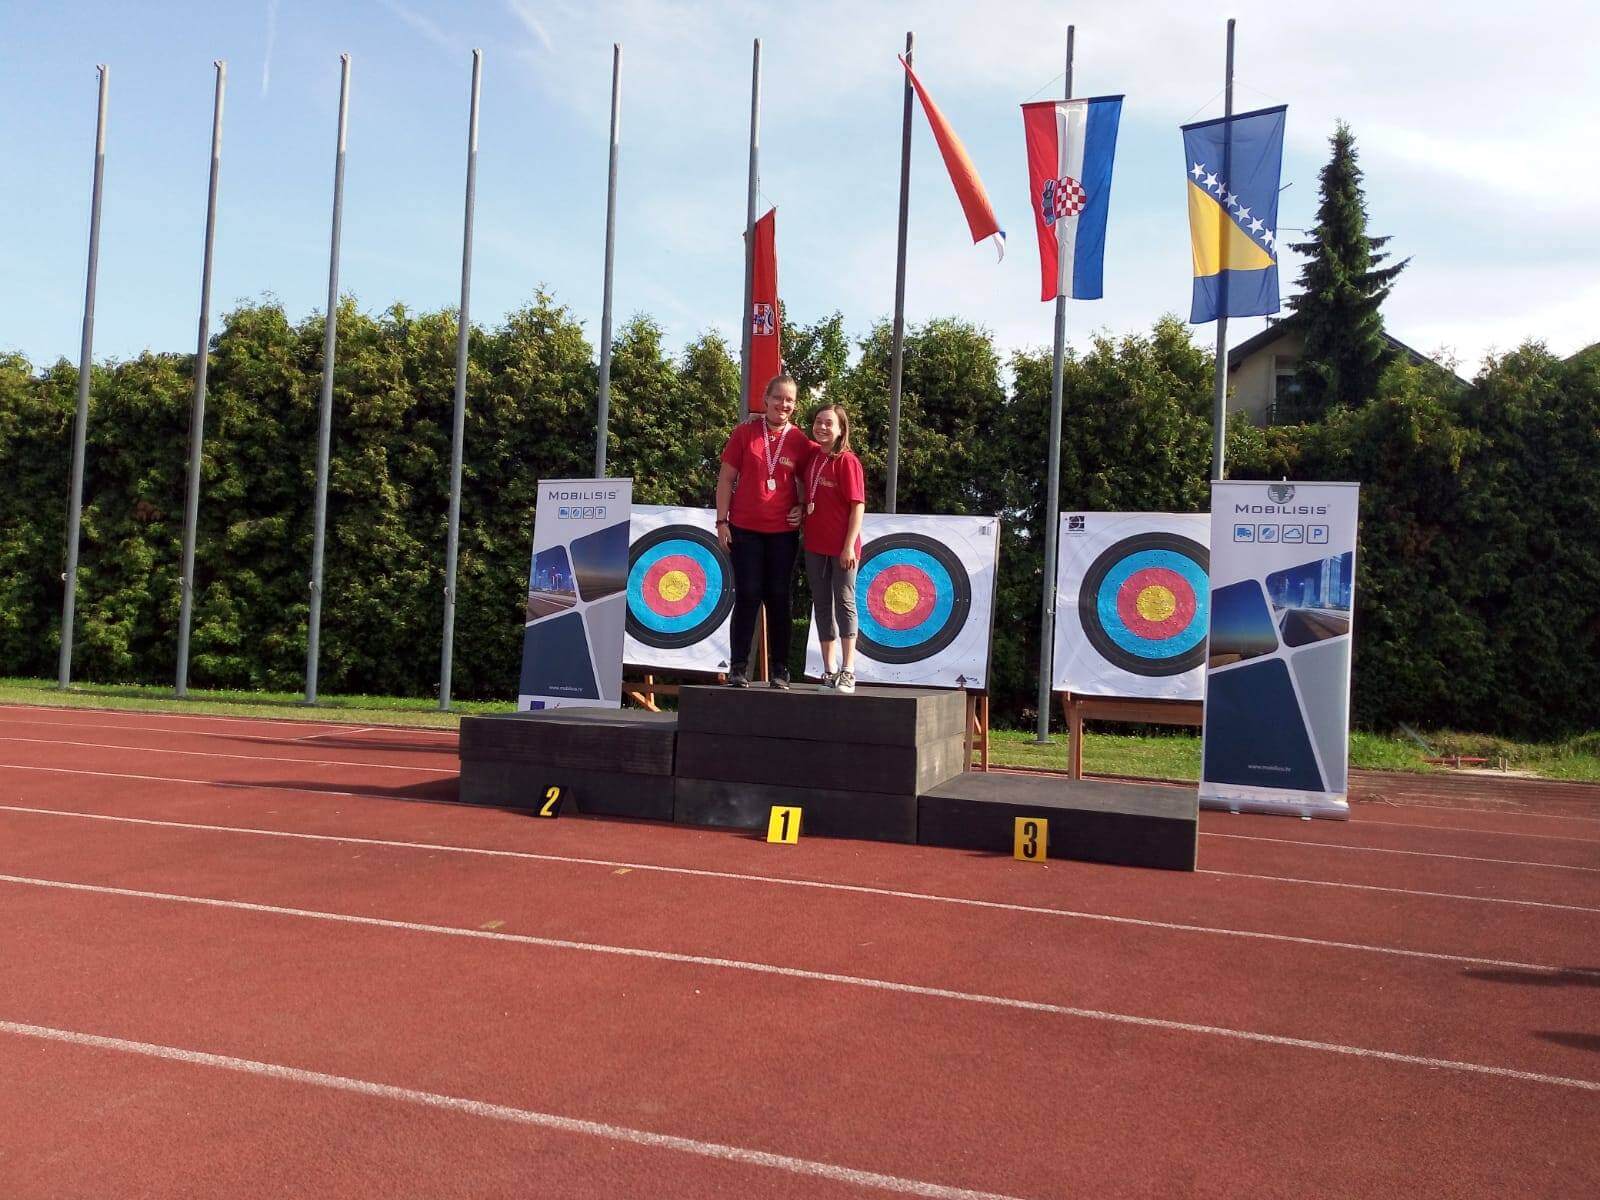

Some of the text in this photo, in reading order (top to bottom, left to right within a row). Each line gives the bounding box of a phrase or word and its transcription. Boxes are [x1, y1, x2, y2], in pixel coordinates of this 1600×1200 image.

[548, 491, 616, 500] MOBILISIS
[1235, 504, 1327, 514] MOBILISIS
[540, 786, 560, 817] 2
[780, 810, 790, 841] 1
[1023, 821, 1038, 859] 3
